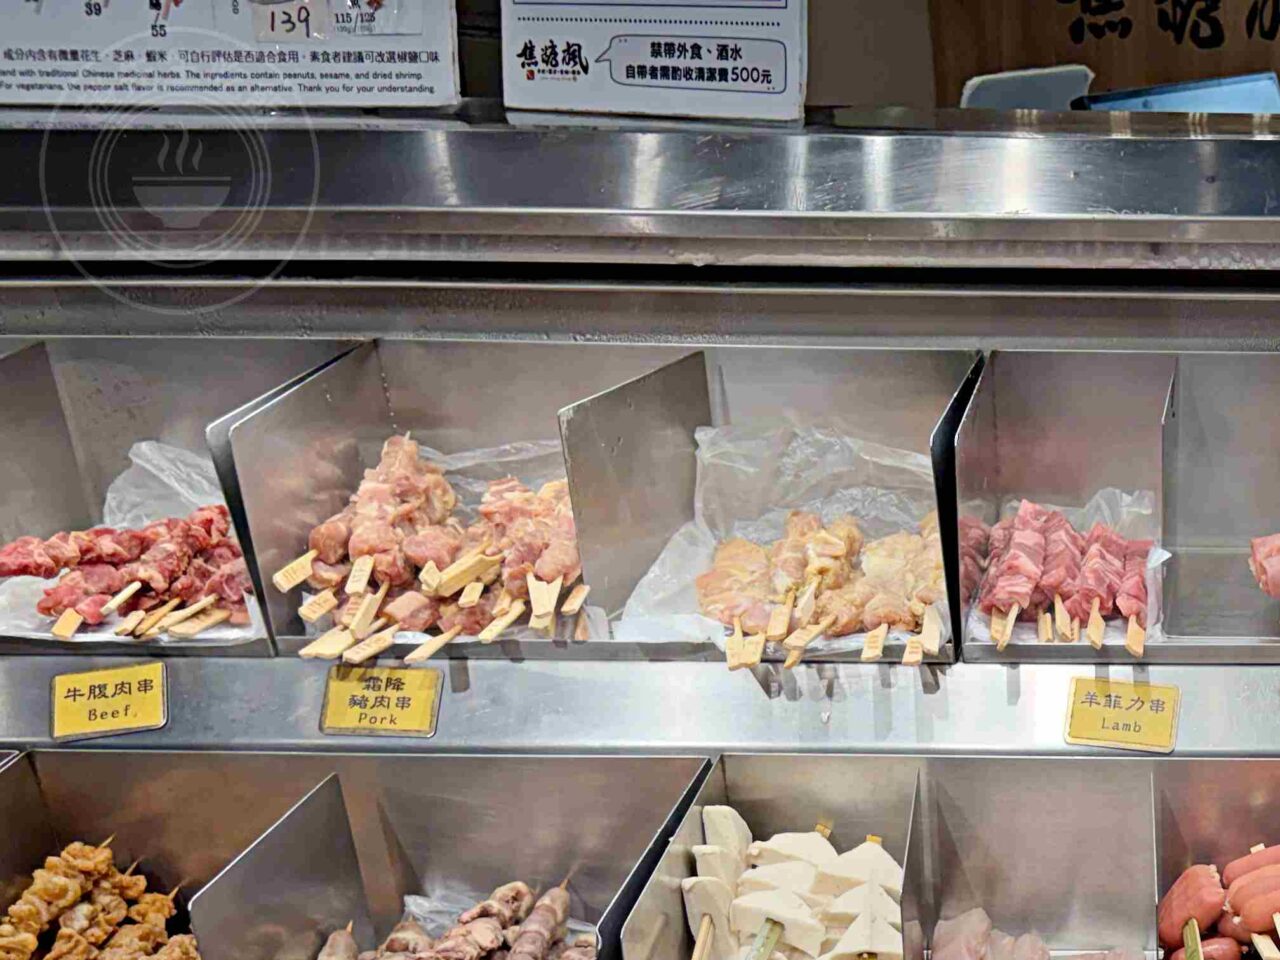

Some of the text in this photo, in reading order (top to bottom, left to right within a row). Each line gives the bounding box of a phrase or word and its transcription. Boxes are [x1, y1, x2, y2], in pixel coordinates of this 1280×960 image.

[151, 24, 167, 38] 55
[269, 6, 311, 39] 139
[38, 69, 79, 78] traditional
[82, 69, 115, 78] Chinese
[184, 70, 200, 79] The
[203, 70, 248, 80] ingredients
[250, 71, 280, 79] contain
[354, 71, 370, 79] and
[372, 71, 393, 79] dried
[166, 84, 223, 92] recommended
[297, 84, 322, 92] Thank
[324, 85, 340, 94] you
[342, 84, 354, 92] for
[356, 85, 375, 93] your
[63, 678, 154, 702] 牛腹肉串
[362, 676, 406, 692] 霜降
[348, 694, 412, 711] 豬肉串
[1080, 690, 1166, 714] 羊菲力串
[88, 704, 131, 721] Beef
[358, 711, 398, 726] Pork
[1101, 716, 1142, 733] Lamb
